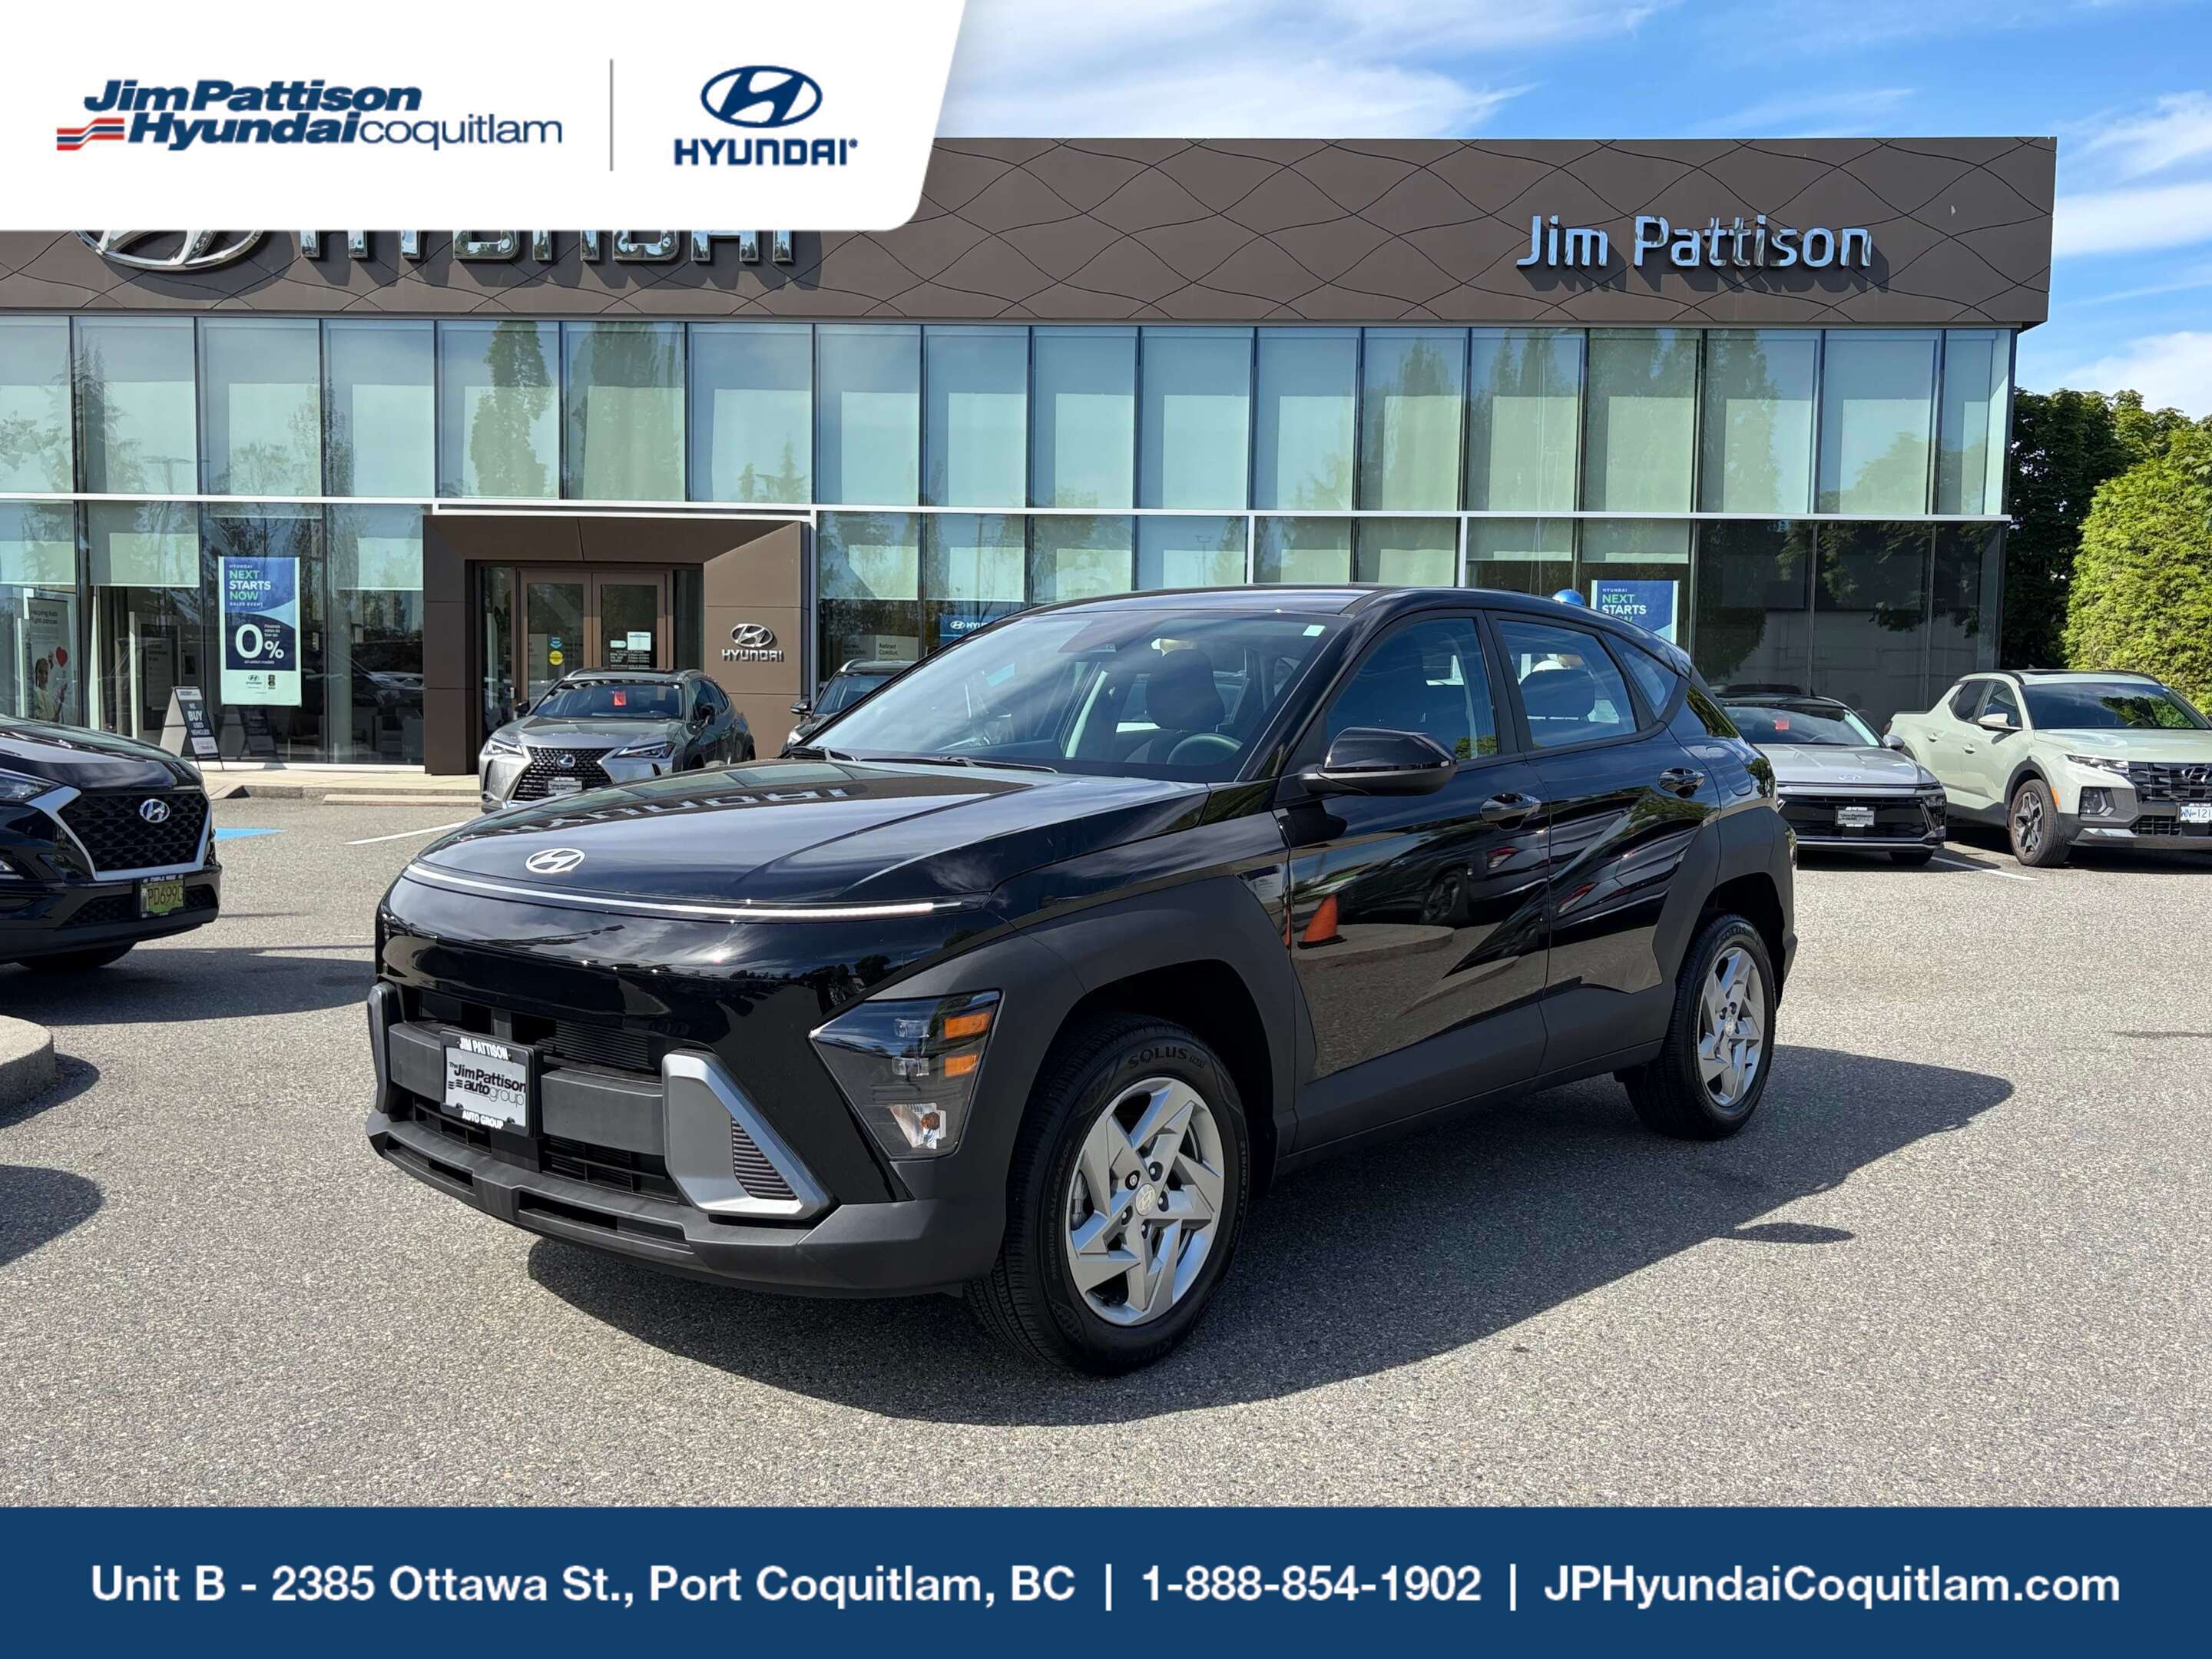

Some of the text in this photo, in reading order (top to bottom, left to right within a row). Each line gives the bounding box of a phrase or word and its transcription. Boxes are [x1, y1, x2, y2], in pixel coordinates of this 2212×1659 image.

[1516, 214, 1873, 268] Jim Pattison
[229, 570, 260, 579] NEXT
[229, 581, 272, 591] STARTS
[229, 591, 259, 601] NOW
[1602, 594, 1635, 604] NEXT
[1601, 604, 1647, 615] STARTS
[722, 649, 783, 661] HYUNDAI
[187, 710, 203, 721] BUY
[459, 1037, 508, 1060] JIM PATTISON
[1128, 1046, 1187, 1069] SOLUS
[462, 1110, 504, 1130] AUTO GROUP
